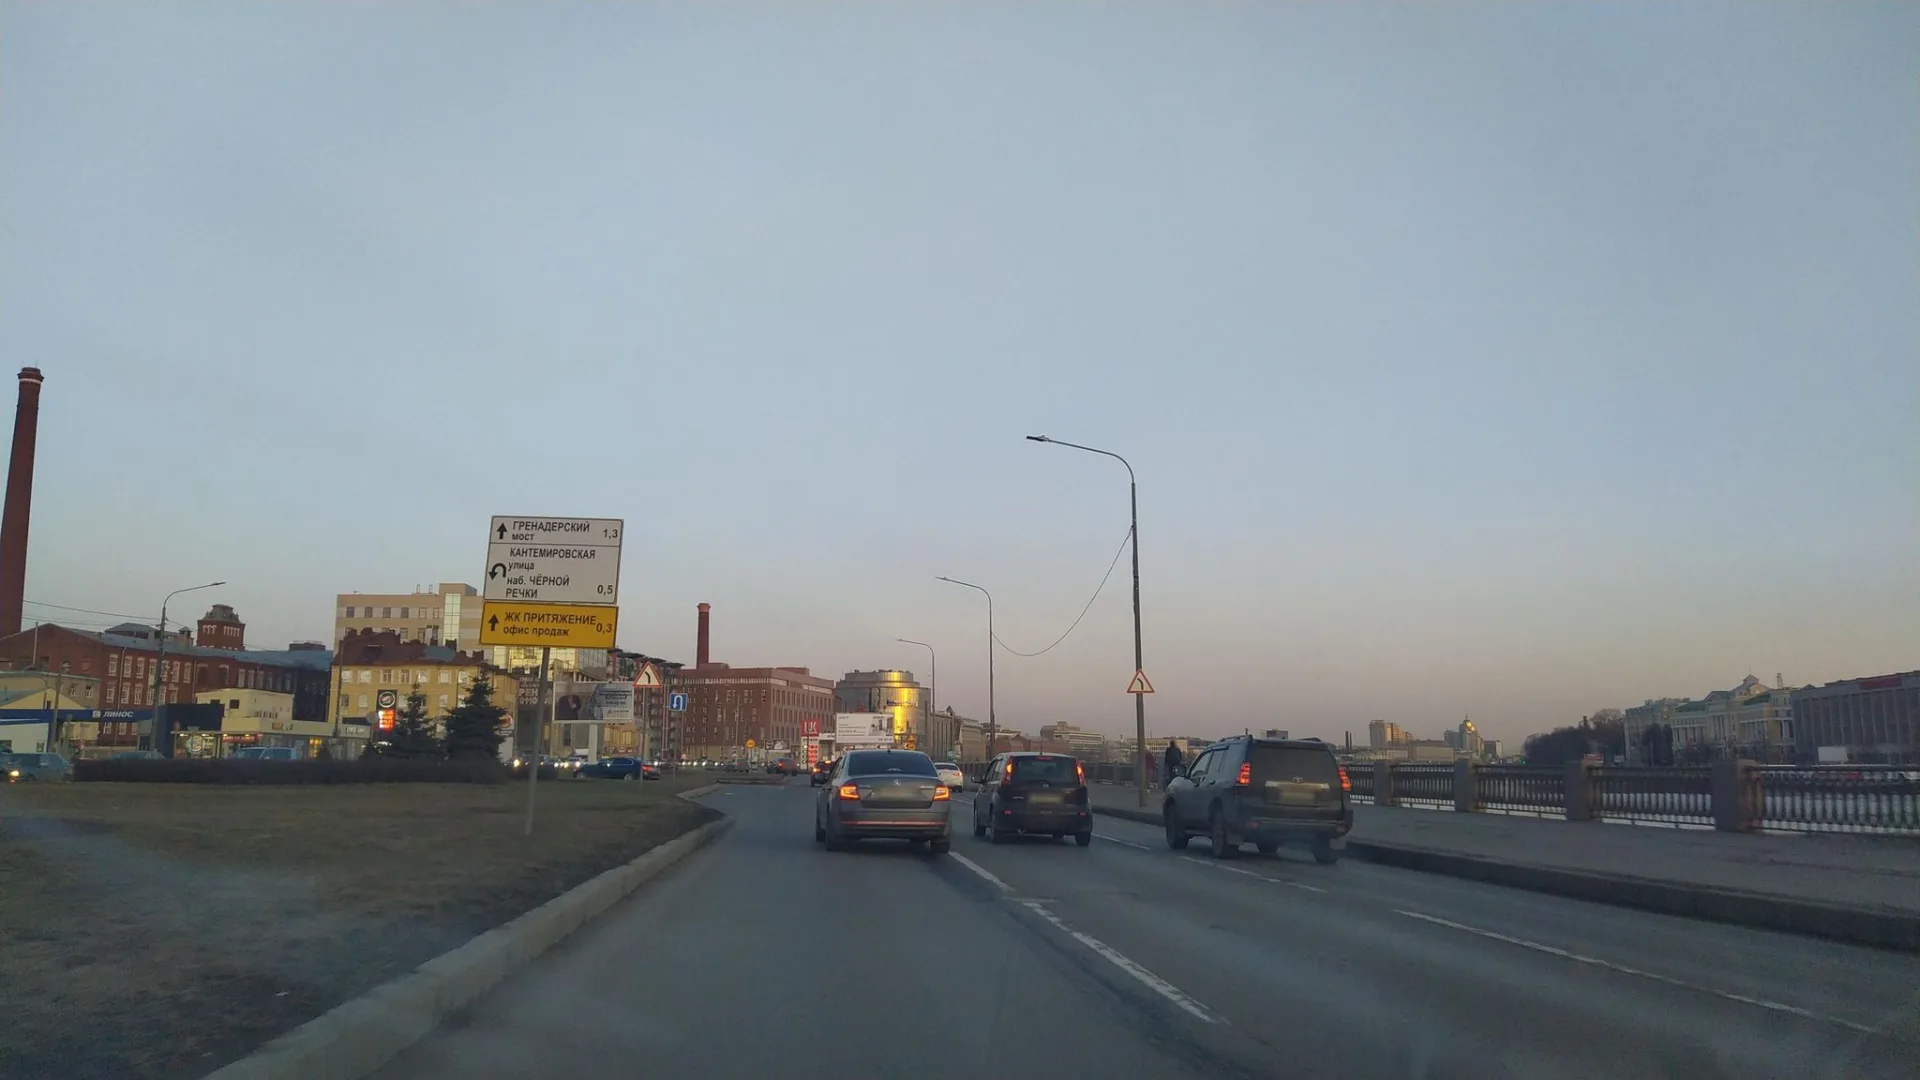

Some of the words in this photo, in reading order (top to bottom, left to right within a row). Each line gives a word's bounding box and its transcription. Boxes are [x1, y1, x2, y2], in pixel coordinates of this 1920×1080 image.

[513, 521, 590, 532] ГРЕНАДЕРСКИЙ
[603, 529, 618, 539] 1,3
[509, 548, 596, 559] КАНТЕМИРОВСКАЯ
[507, 562, 535, 571] улица
[506, 576, 526, 585] наб.
[529, 574, 570, 586] ЧЁРНОЙ
[505, 588, 538, 598] РЕЧКИ
[597, 584, 613, 595] 0,5
[505, 612, 521, 621] ЖК
[523, 612, 596, 625] ПРИТЯЖЕНИЕ
[503, 626, 529, 636] офис
[532, 627, 569, 637] продаж
[596, 623, 612, 633] 0,3
